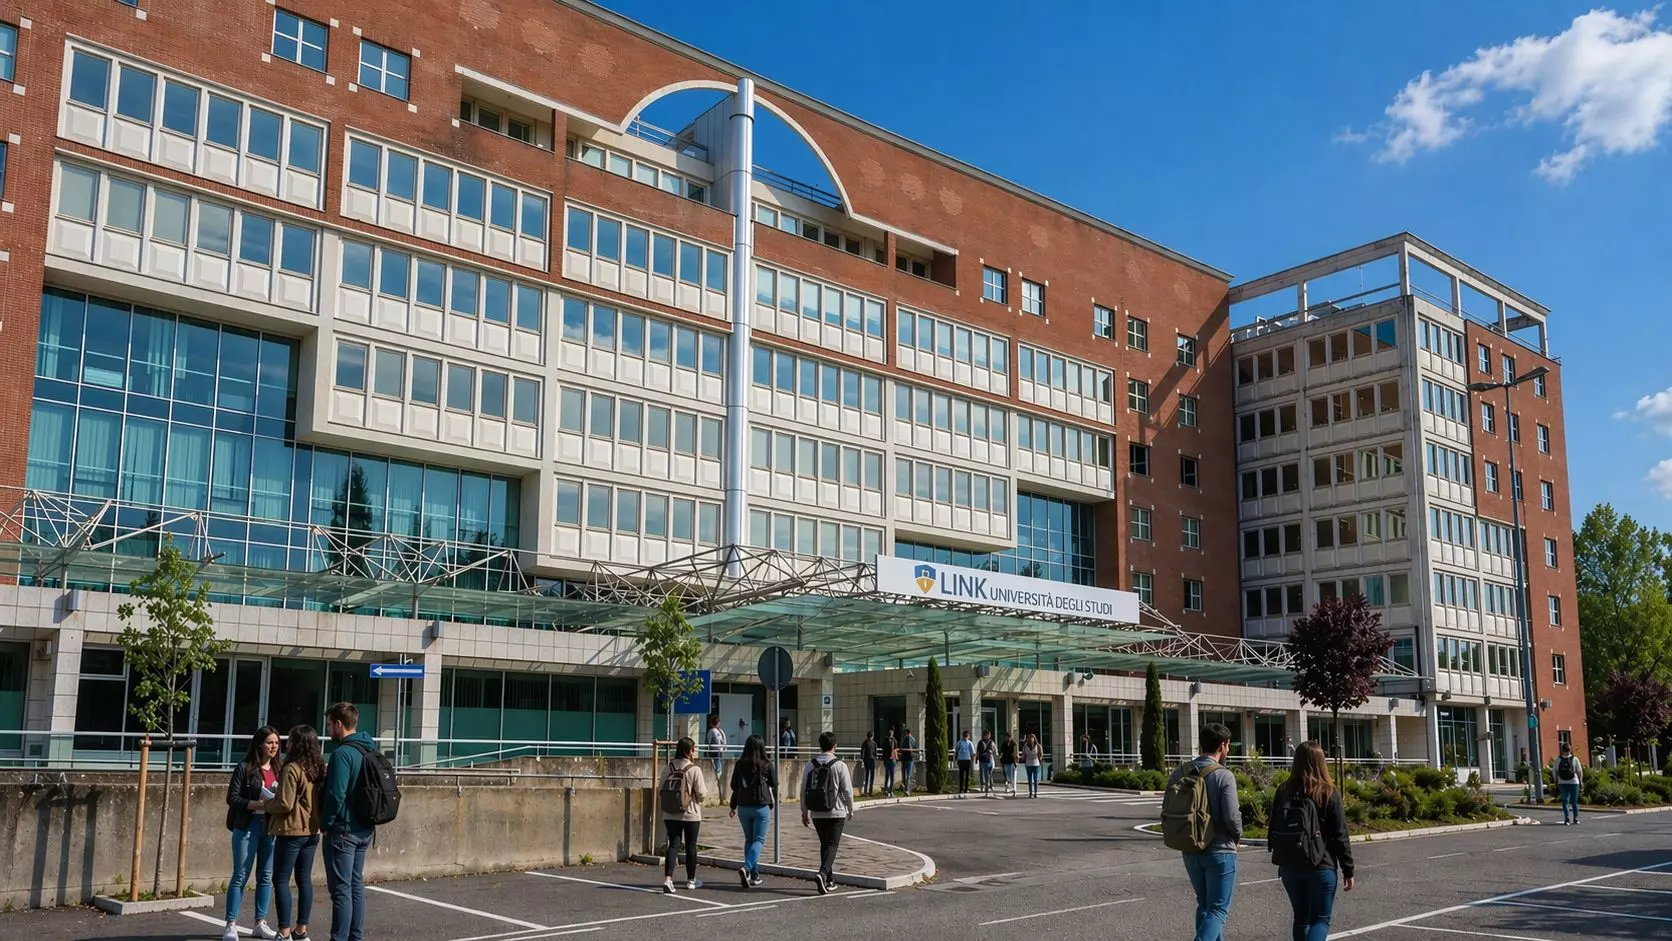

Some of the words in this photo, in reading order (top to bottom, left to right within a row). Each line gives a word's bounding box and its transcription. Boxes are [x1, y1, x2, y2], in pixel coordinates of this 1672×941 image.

[941, 571, 988, 599] LINK
[990, 587, 1053, 608] UNIVERSITÀ
[1055, 597, 1083, 611] DEGLI
[1085, 601, 1112, 615] STUDI
